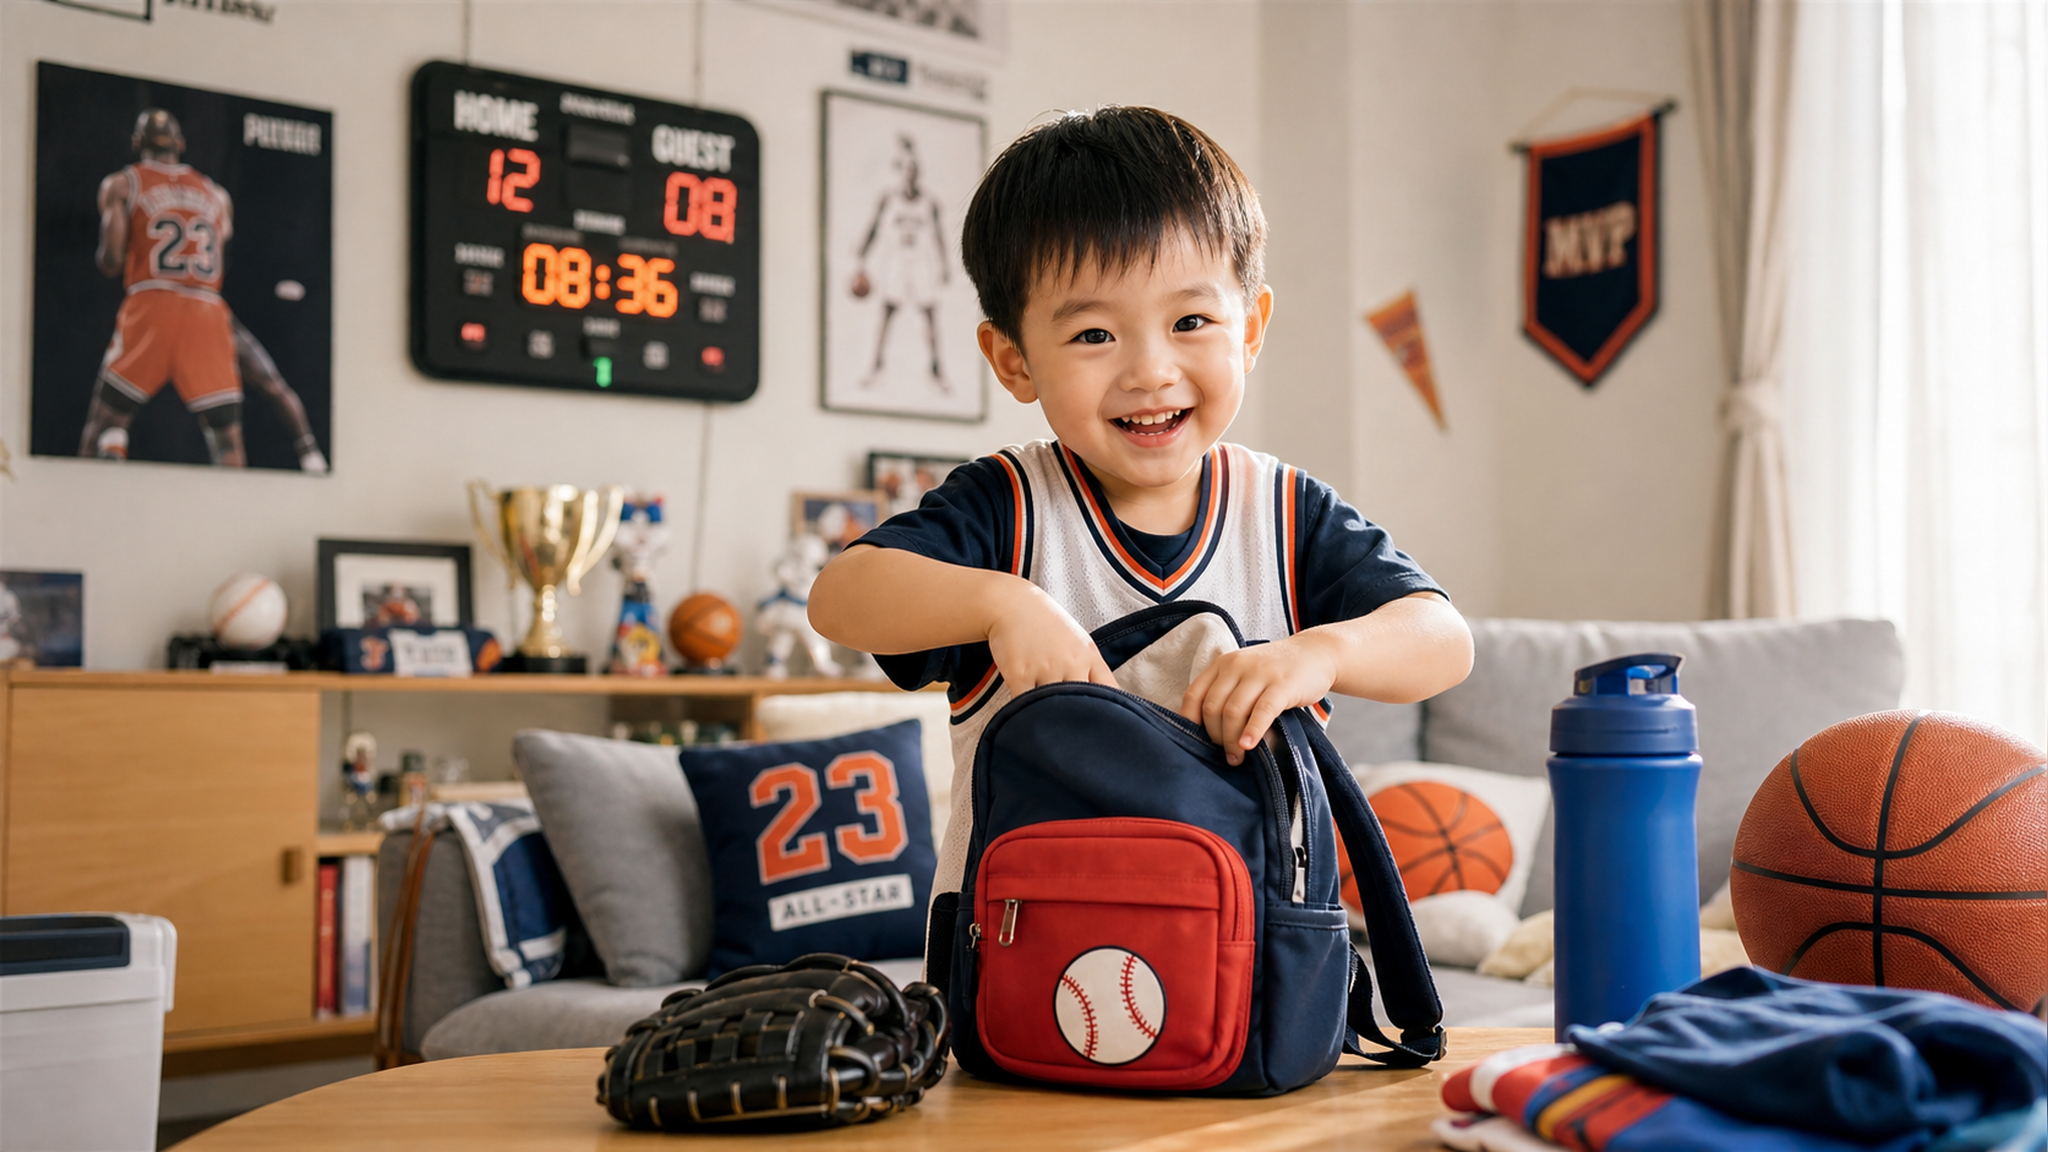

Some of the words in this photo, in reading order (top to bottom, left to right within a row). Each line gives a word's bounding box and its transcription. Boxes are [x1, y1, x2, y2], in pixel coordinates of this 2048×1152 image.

[454, 90, 539, 142] HOME
[652, 124, 736, 173] GUEST
[487, 147, 541, 212] 12
[663, 171, 738, 242] 08
[147, 211, 221, 283] 23
[1543, 200, 1637, 279] MVP
[521, 242, 679, 318] 08:36
[593, 356, 612, 387] 1
[748, 750, 909, 886] 23
[782, 883, 903, 922] ALL-STAR
